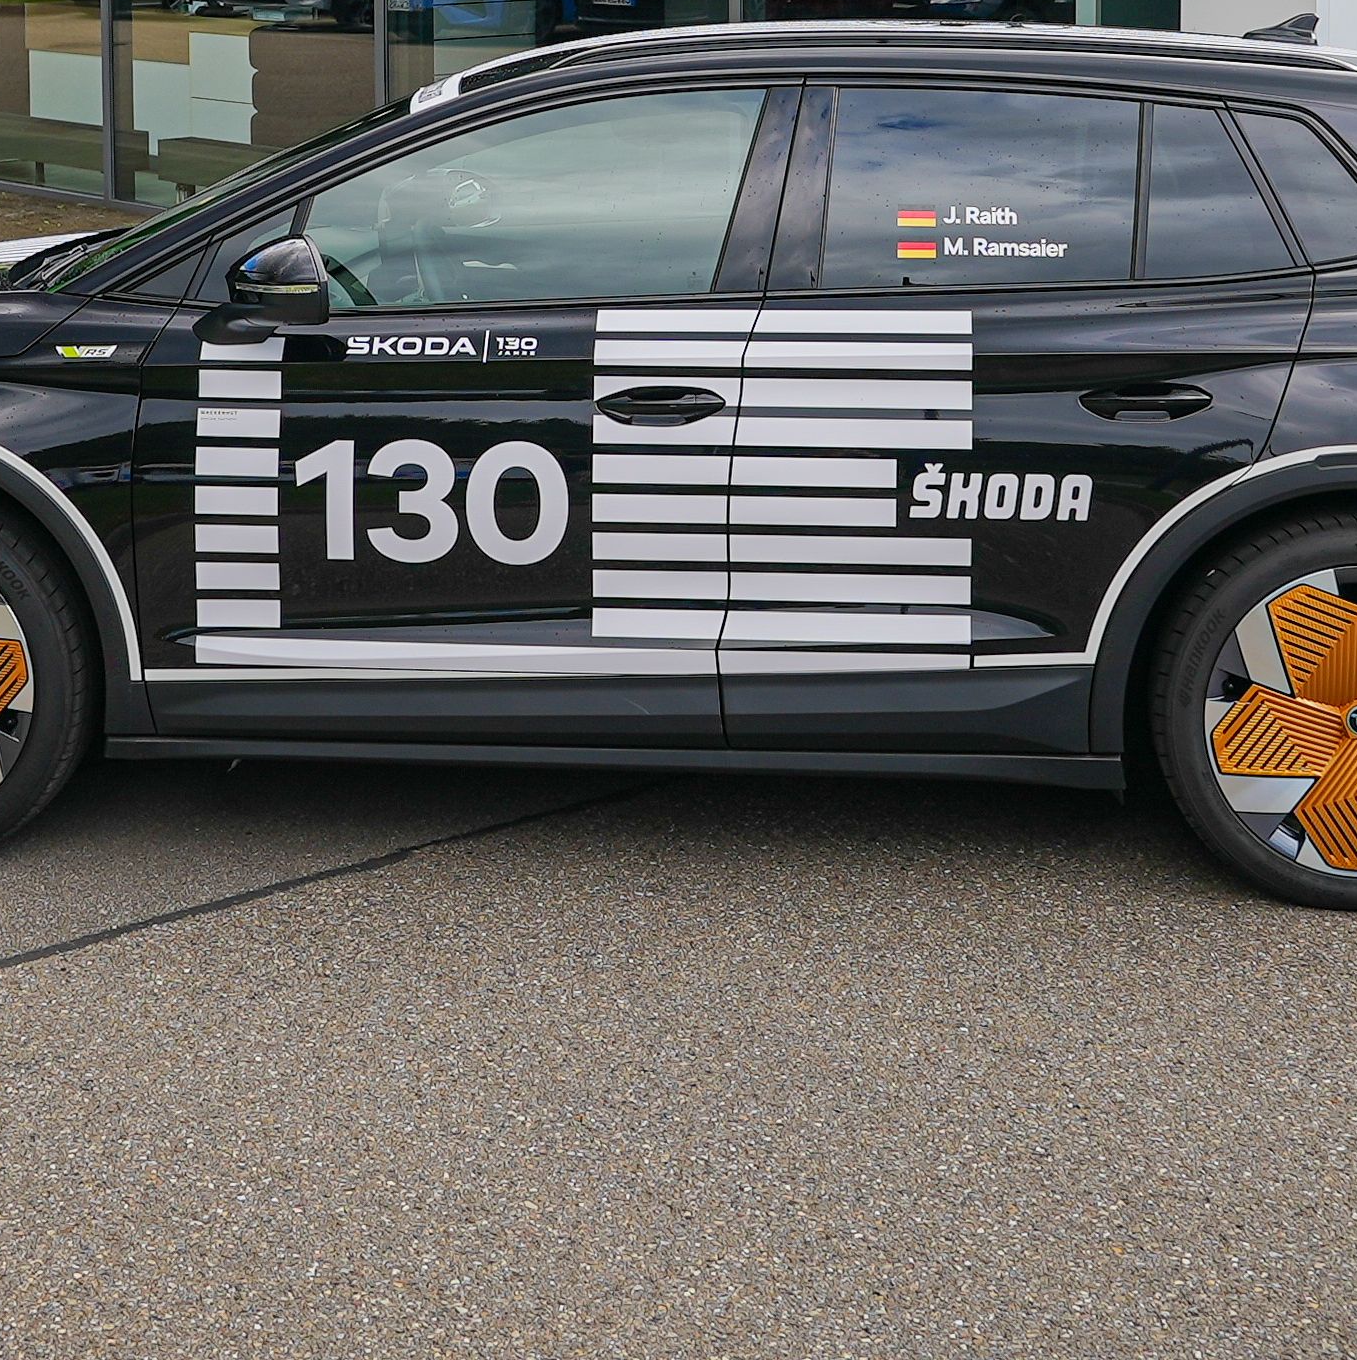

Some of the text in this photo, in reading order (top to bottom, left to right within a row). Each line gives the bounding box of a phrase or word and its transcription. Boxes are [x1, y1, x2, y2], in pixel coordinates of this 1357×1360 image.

[943, 206, 1018, 225] J. Raith
[944, 238, 1068, 258] M. Ramsaier
[495, 336, 538, 350] 130
[295, 438, 569, 566] 130
[909, 463, 1093, 521] ŠKODA
